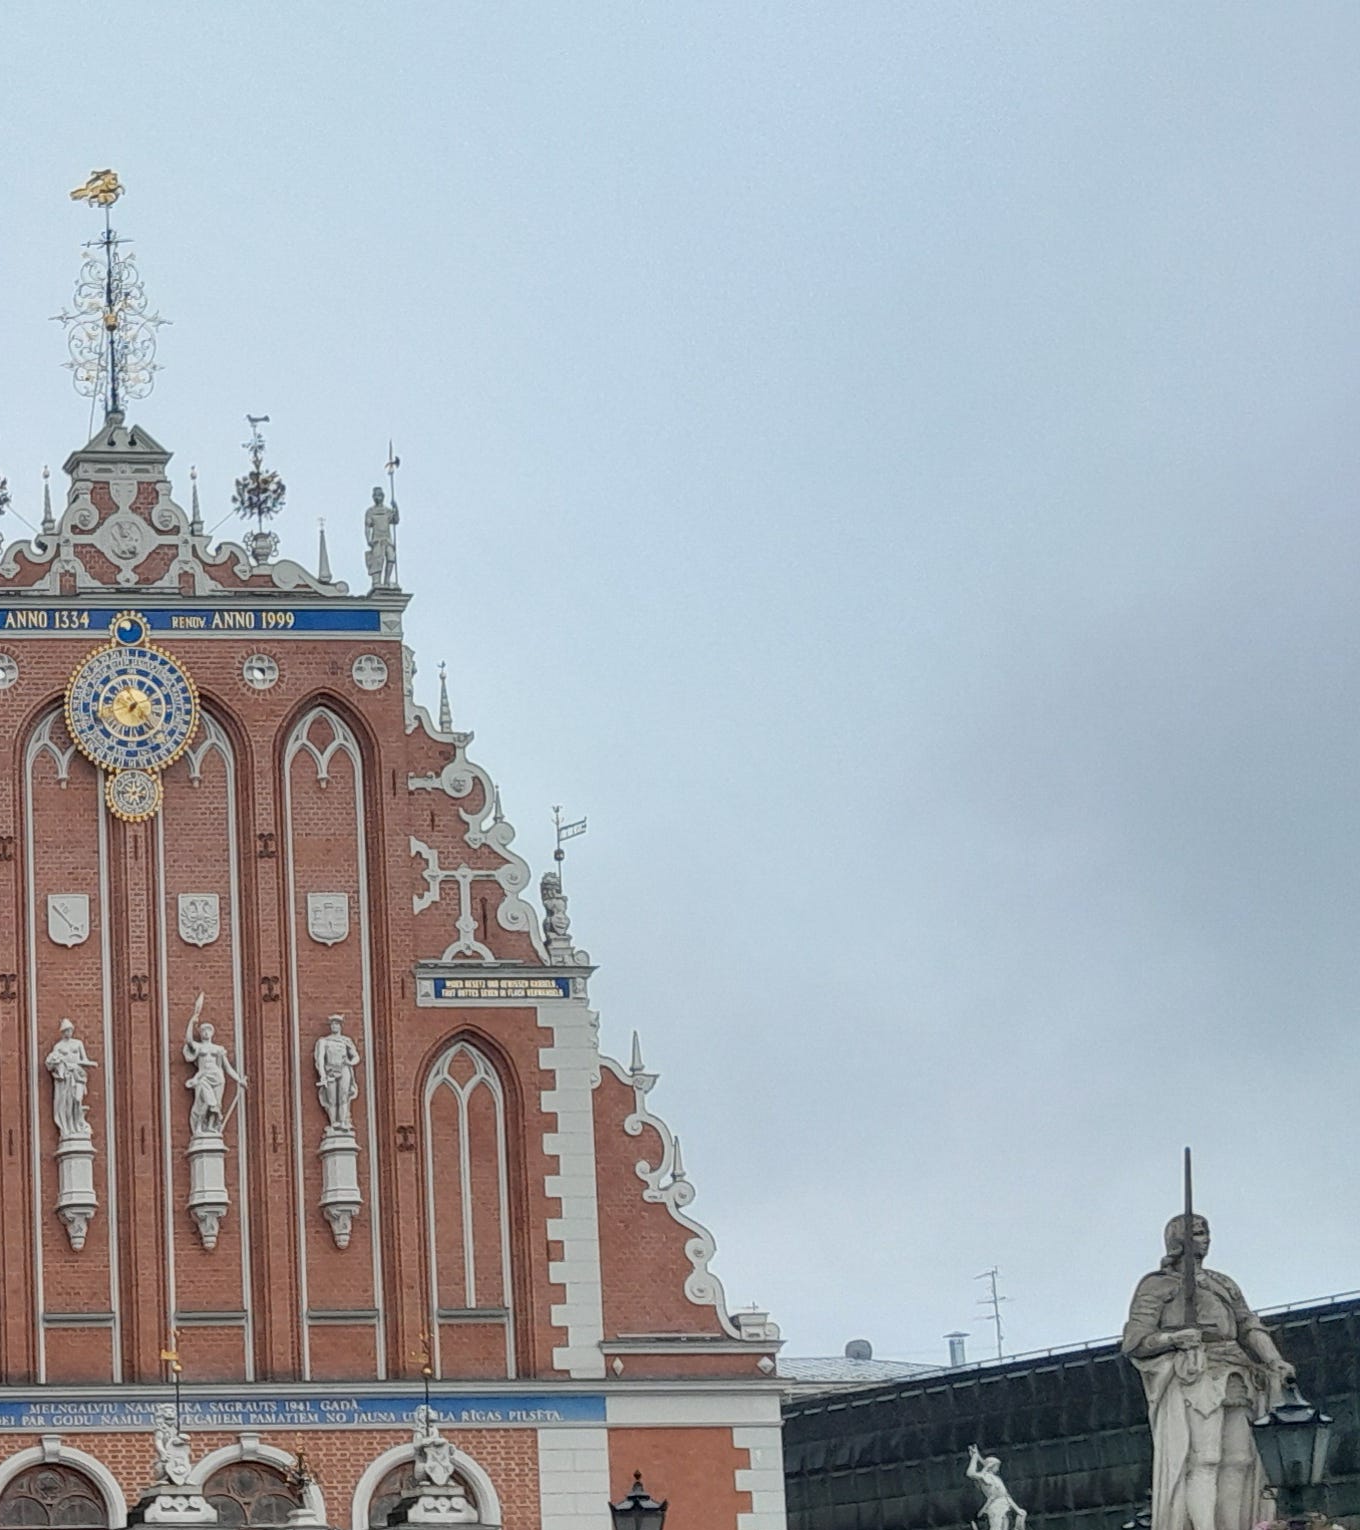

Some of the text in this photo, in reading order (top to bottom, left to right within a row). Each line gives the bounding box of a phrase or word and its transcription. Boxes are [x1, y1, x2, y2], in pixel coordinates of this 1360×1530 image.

[5, 611, 90, 628] ANNO 1334
[212, 611, 255, 629] ANNO
[261, 611, 295, 629] 1999
[22, 1415, 46, 1426] PAR
[52, 1415, 94, 1426] GODU
[326, 1412, 347, 1423] NO
